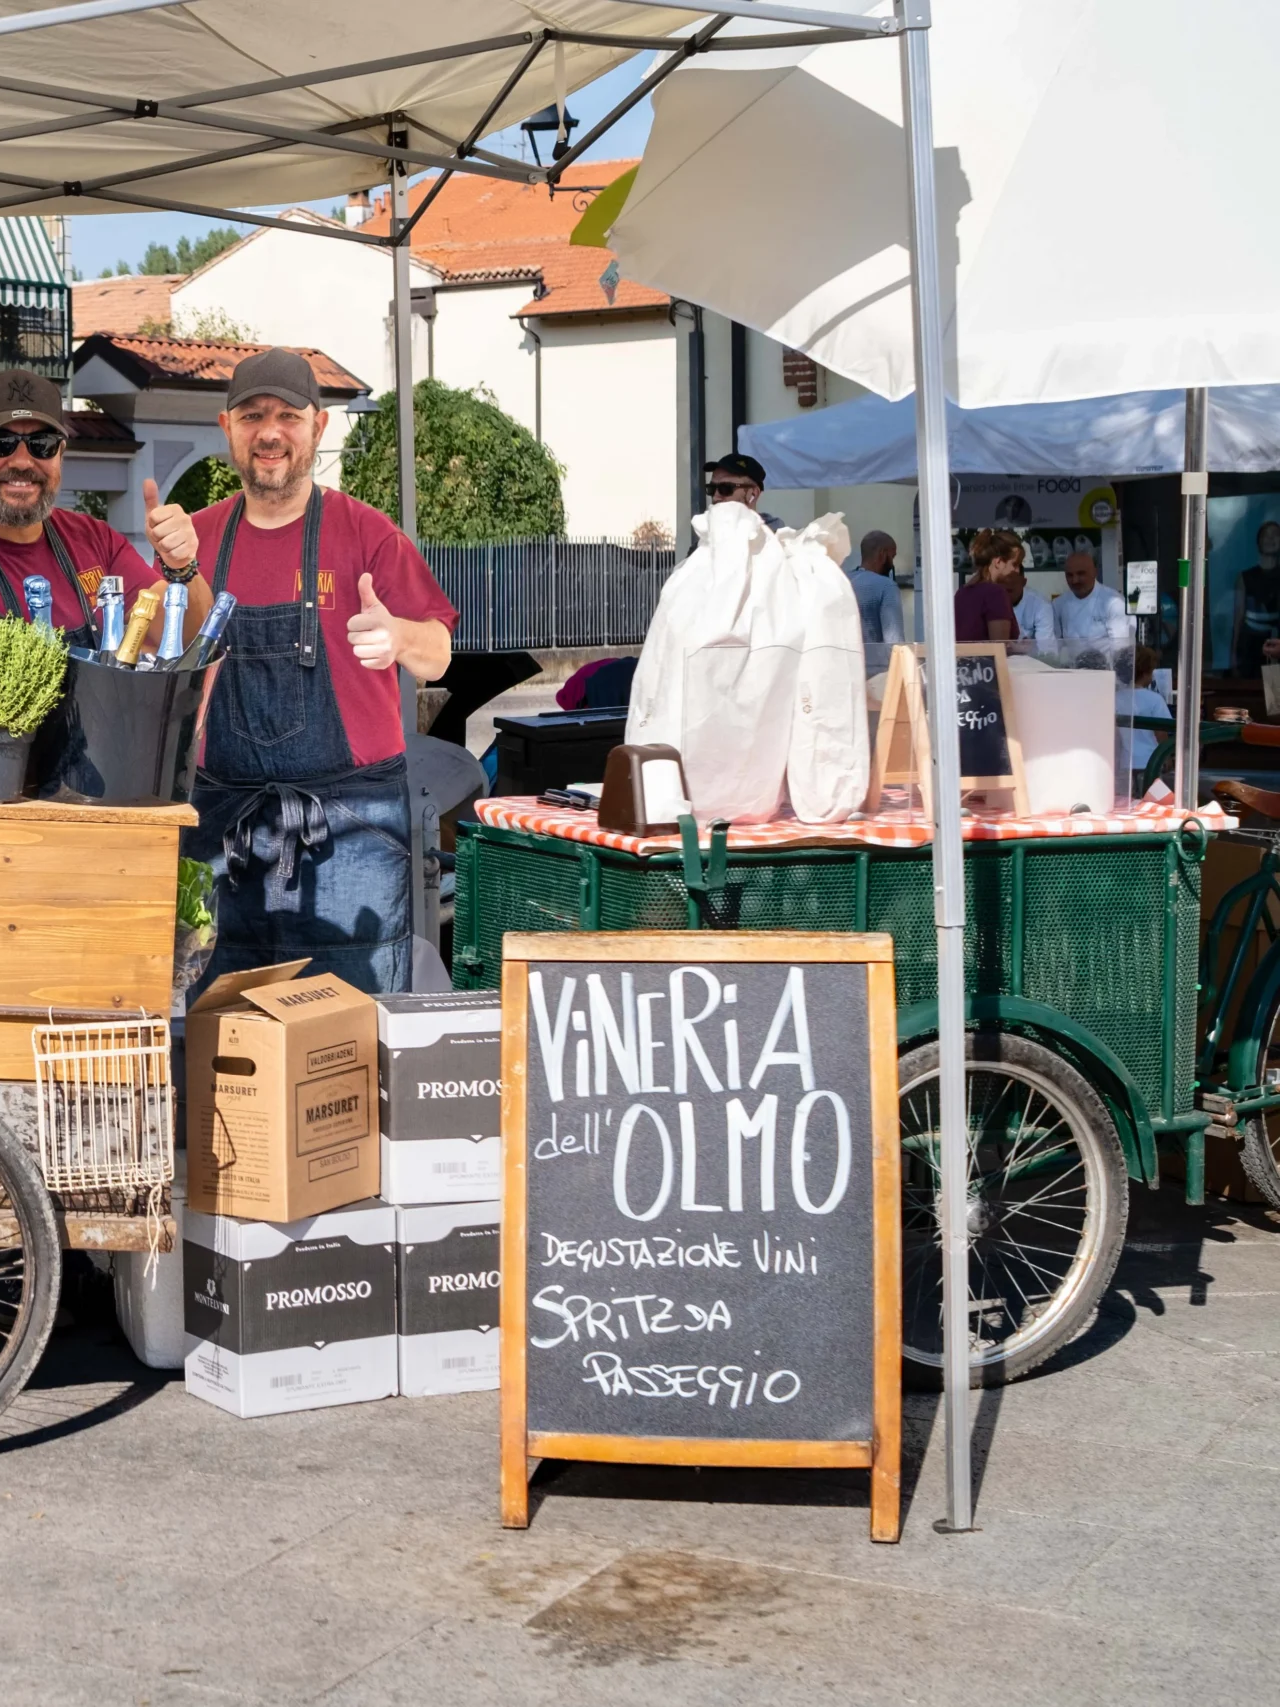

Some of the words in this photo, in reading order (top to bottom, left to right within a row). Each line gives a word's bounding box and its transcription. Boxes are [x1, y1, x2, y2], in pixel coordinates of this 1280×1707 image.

[276, 987, 340, 1007] MARSURET
[210, 1083, 258, 1097] MARSURET
[306, 1095, 359, 1125] MARSURET
[194, 1291, 230, 1316] MONTELVINI
[266, 1280, 372, 1311] PROMOSSO
